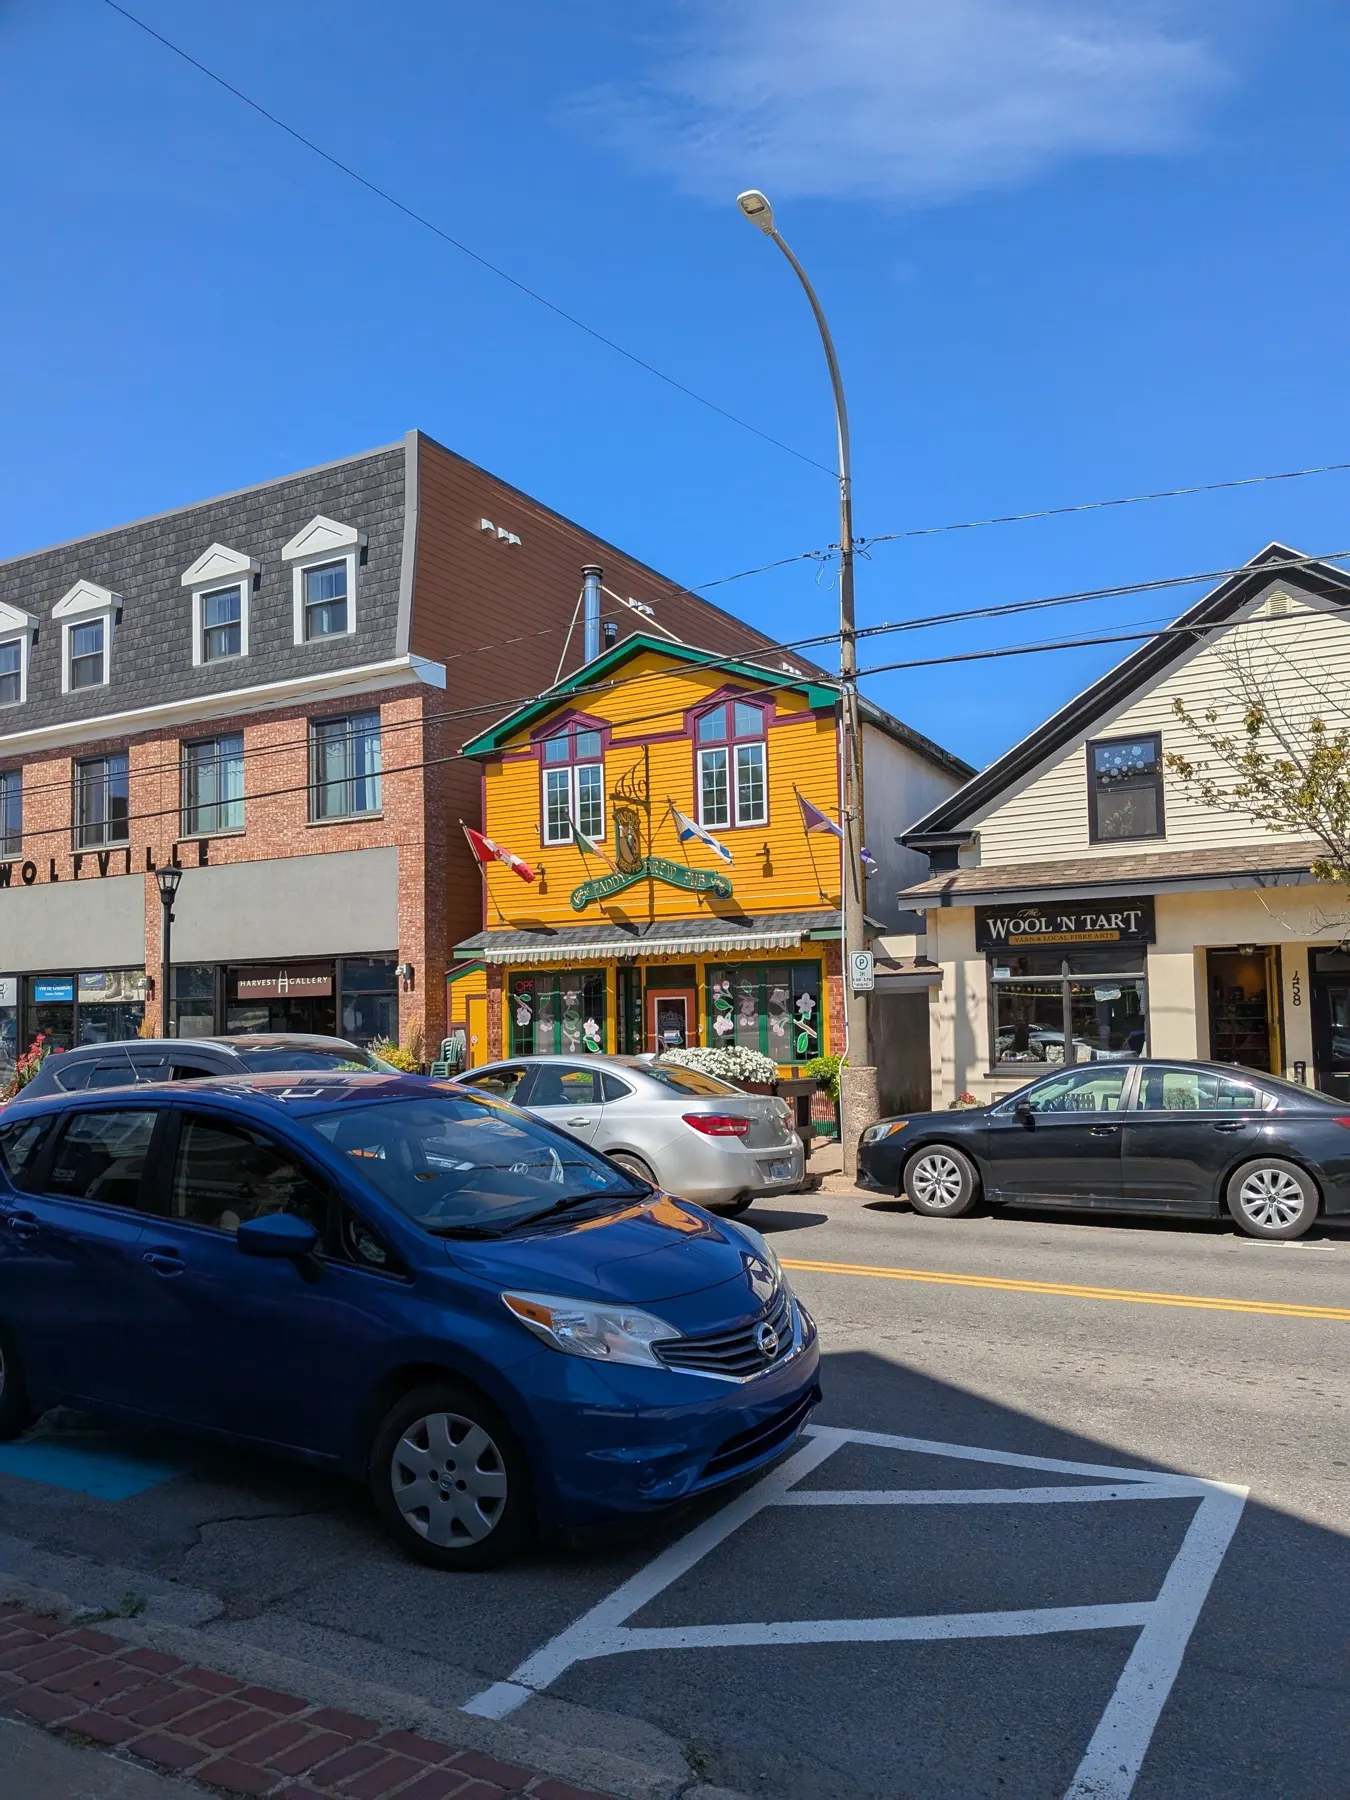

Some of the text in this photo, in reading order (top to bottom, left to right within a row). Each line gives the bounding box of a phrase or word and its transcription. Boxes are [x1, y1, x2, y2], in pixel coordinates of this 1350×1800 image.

[0, 839, 209, 888] WOLFVILLE
[593, 861, 706, 893] PADDY BREW PUB
[986, 910, 1142, 940] WOOL 'N TART
[1017, 908, 1041, 917] The
[240, 978, 277, 987] HARVEST
[289, 976, 328, 985] GALLERY
[1292, 970, 1301, 1006] 458
